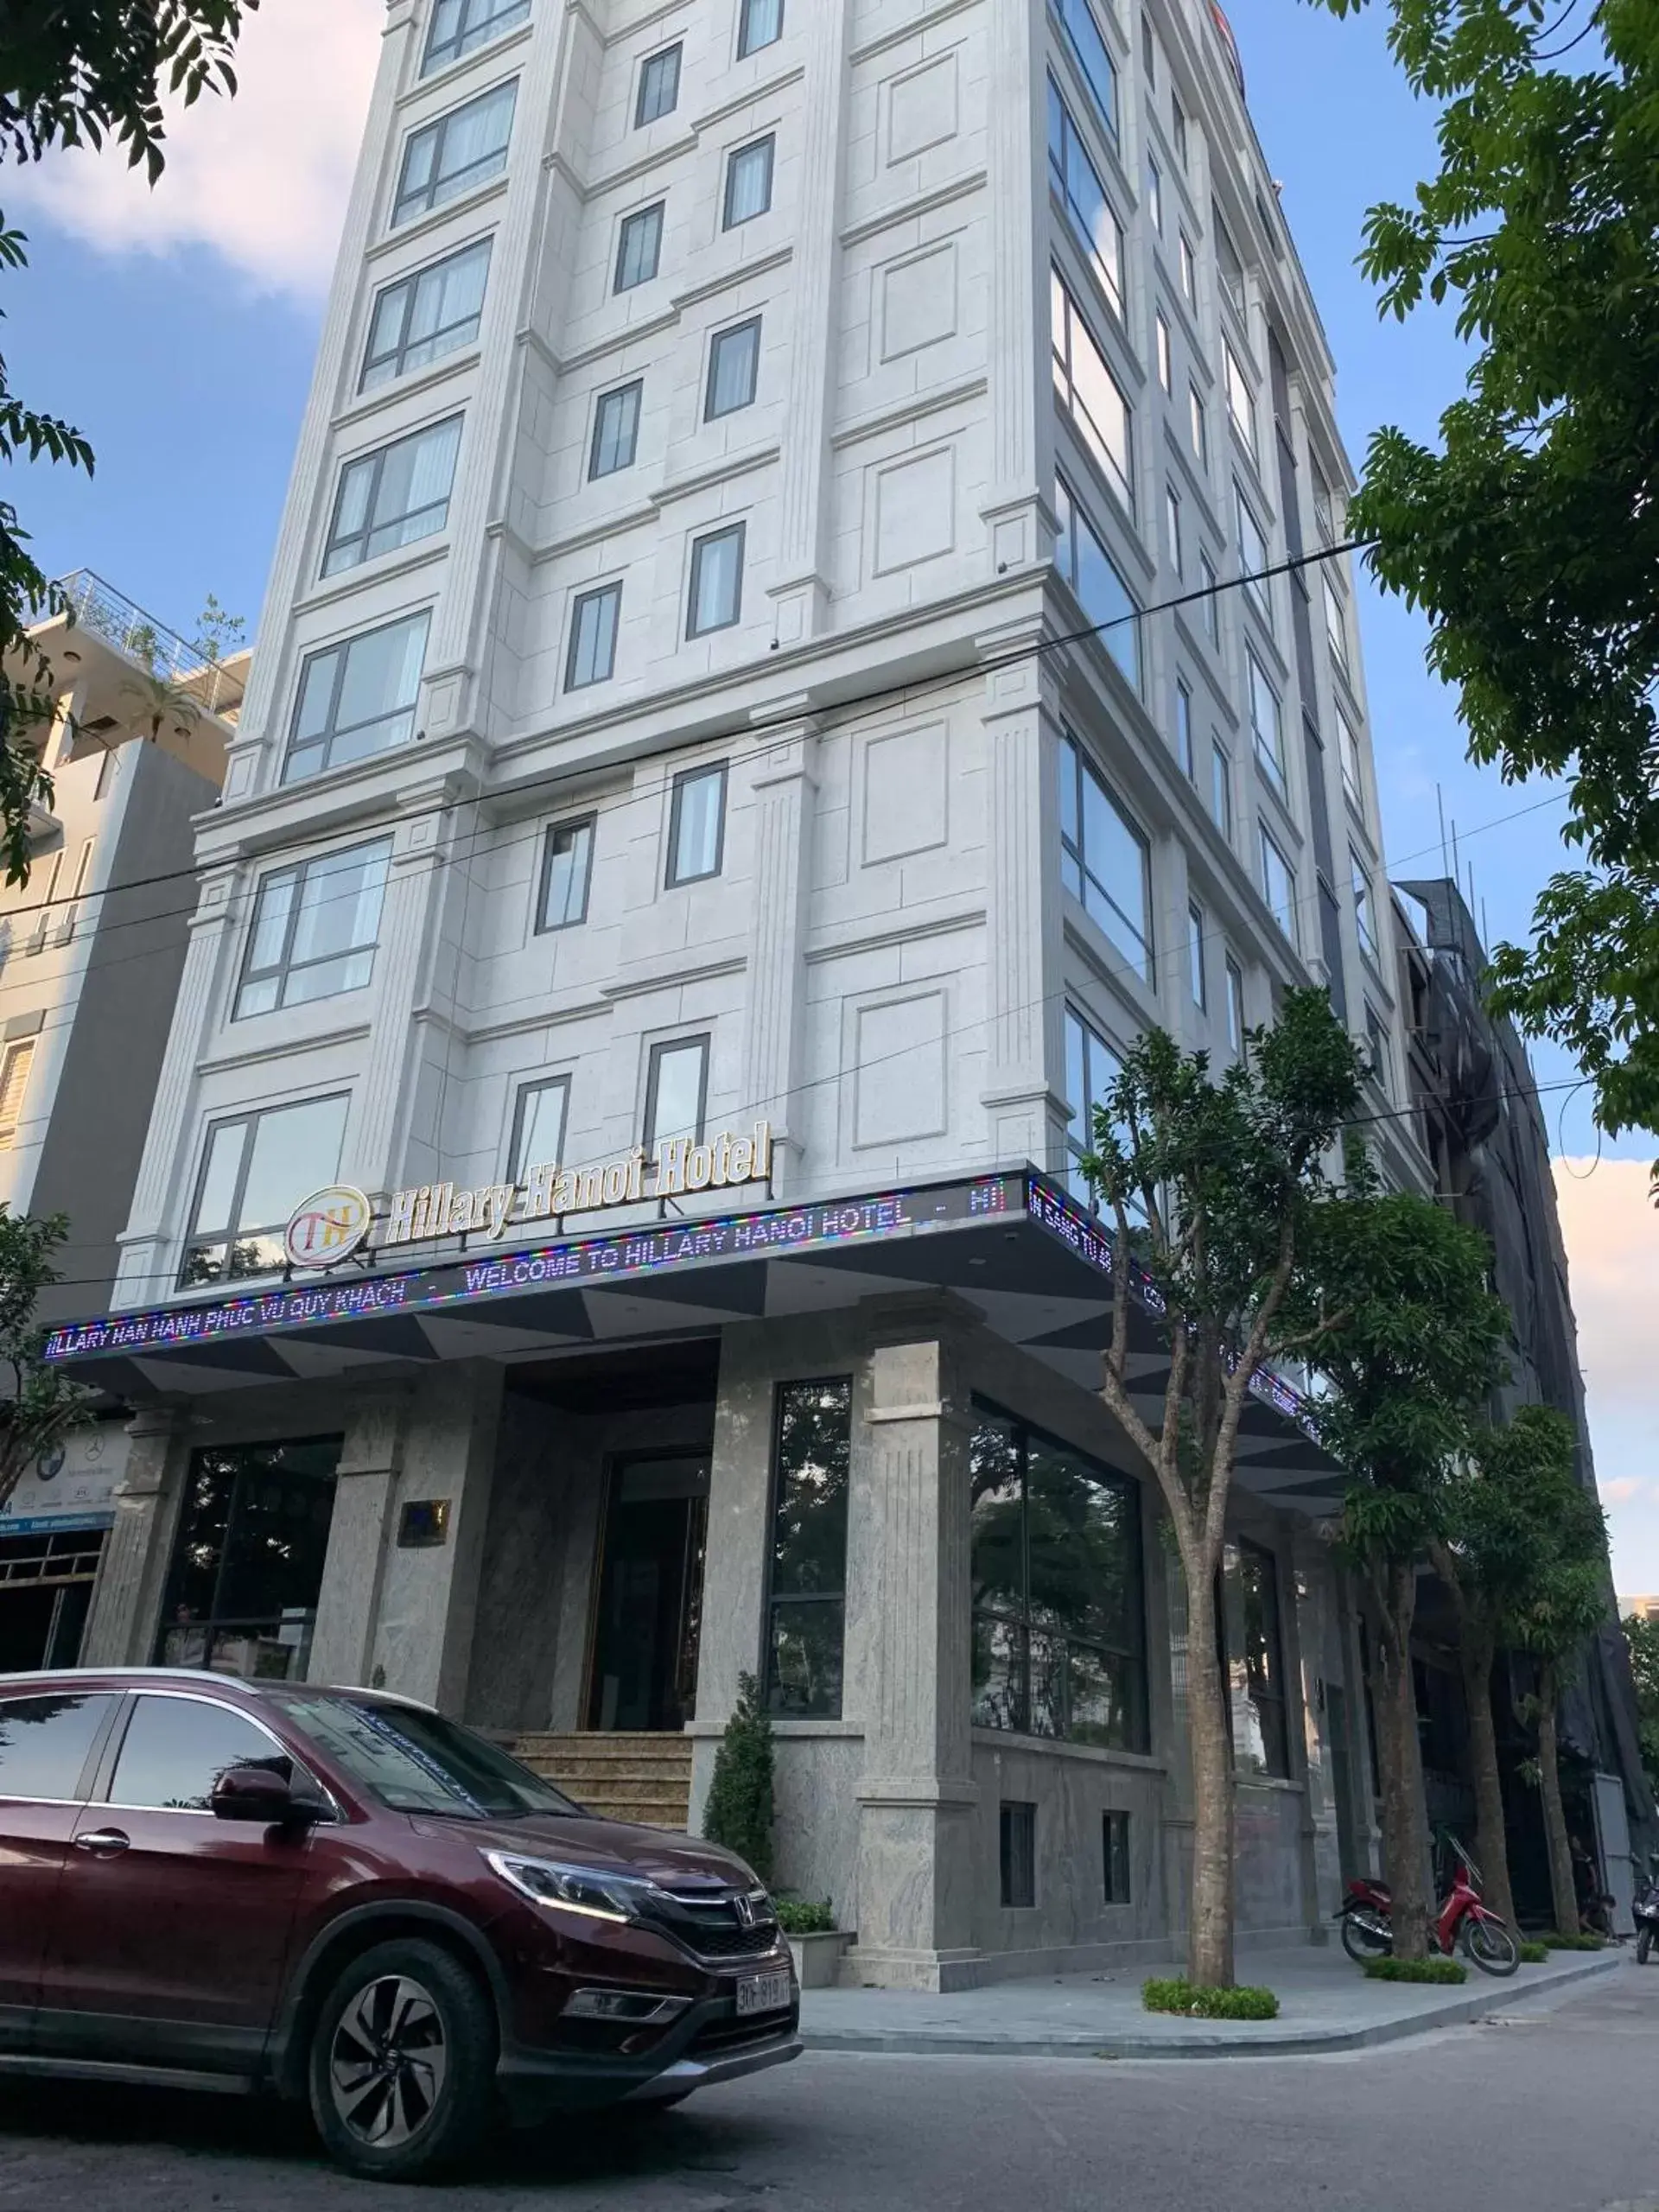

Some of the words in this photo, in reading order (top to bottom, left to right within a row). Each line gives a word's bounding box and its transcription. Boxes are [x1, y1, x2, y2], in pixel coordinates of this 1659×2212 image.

[385, 1181, 513, 1241] Hillary
[523, 1145, 645, 1218] Hanoi
[655, 1120, 771, 1196] Hotel
[112, 1323, 149, 1344] HAN
[151, 1313, 201, 1338] HANH
[205, 1306, 255, 1332] PHUC
[261, 1300, 285, 1321] VU
[289, 1293, 332, 1318] QUY
[334, 1281, 405, 1313] KHACH
[465, 1254, 582, 1291] WELCOME
[588, 1248, 619, 1270] TO
[625, 1230, 727, 1265] HILLARY
[734, 1215, 814, 1248] HANOI
[823, 1200, 912, 1236] HOTEL
